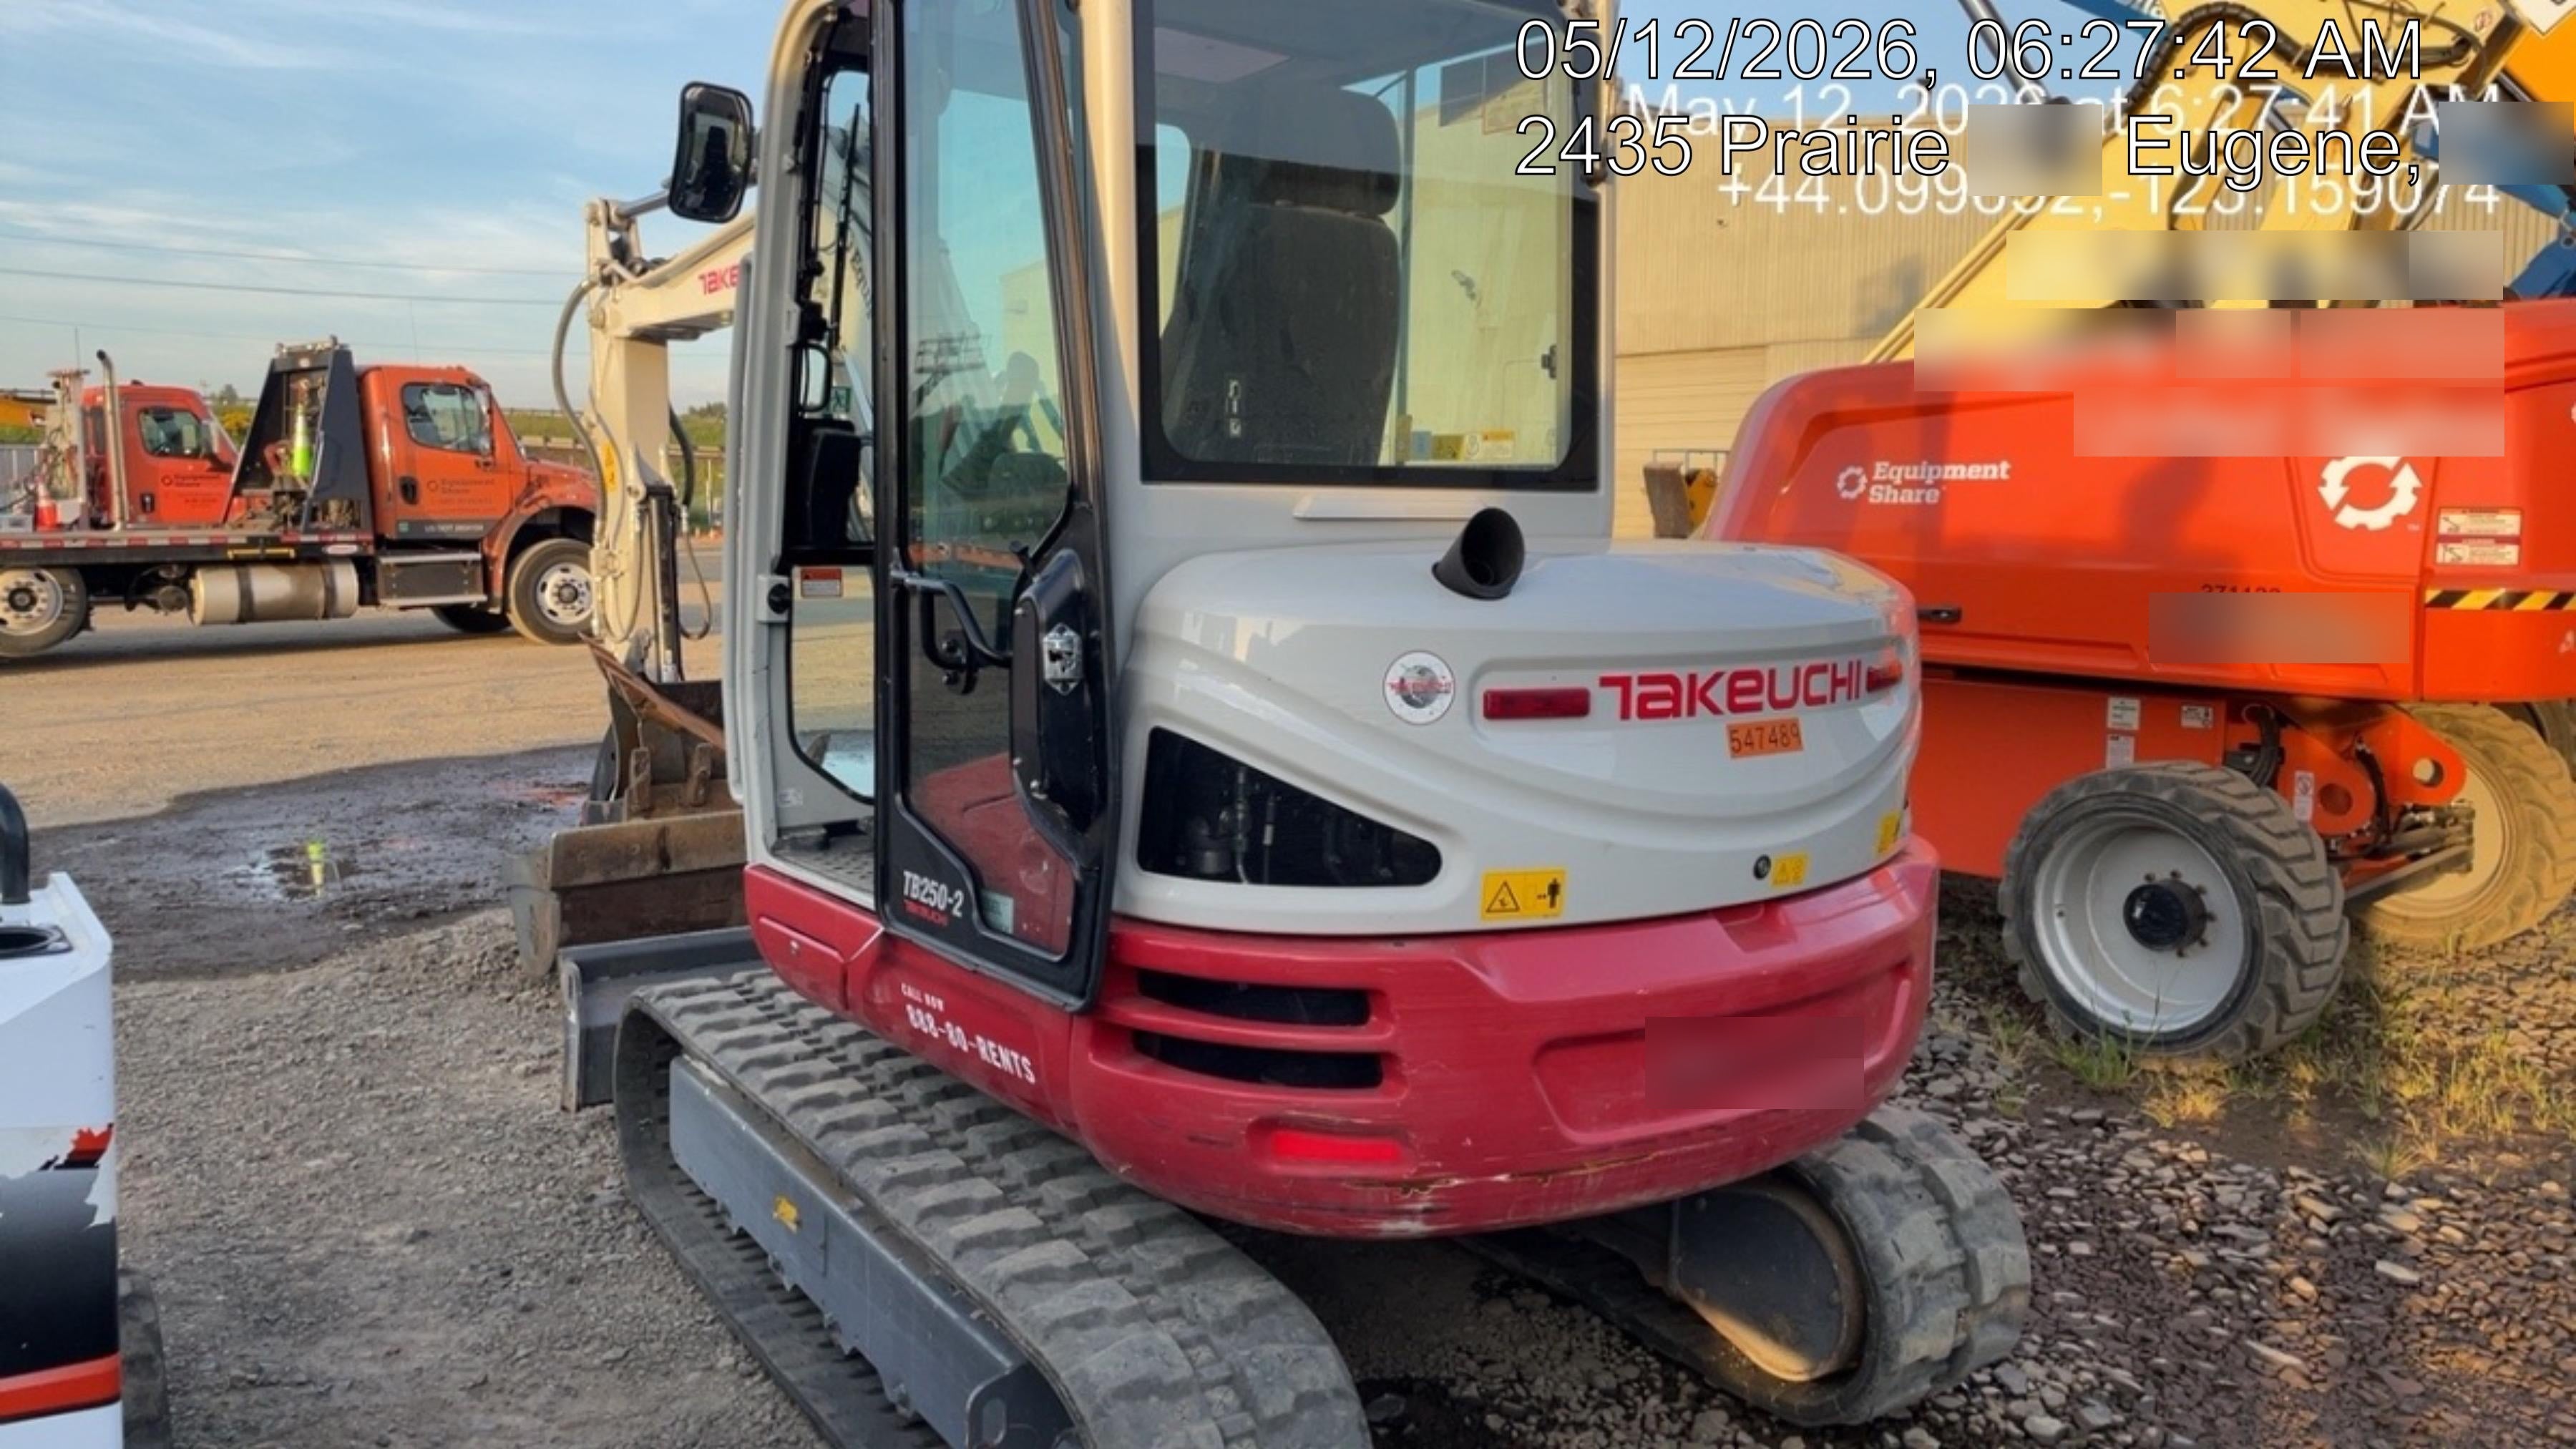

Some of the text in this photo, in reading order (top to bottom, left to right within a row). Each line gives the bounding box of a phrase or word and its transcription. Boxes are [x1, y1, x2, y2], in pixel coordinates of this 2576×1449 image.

[1872, 461, 2011, 485] Equipment
[1869, 484, 1941, 504] Share
[1599, 659, 1860, 721] TAKEUCHI
[1729, 721, 1802, 754] 547489
[903, 869, 965, 918] TB250-2
[905, 1003, 1036, 1085] 888-80-RENTS
